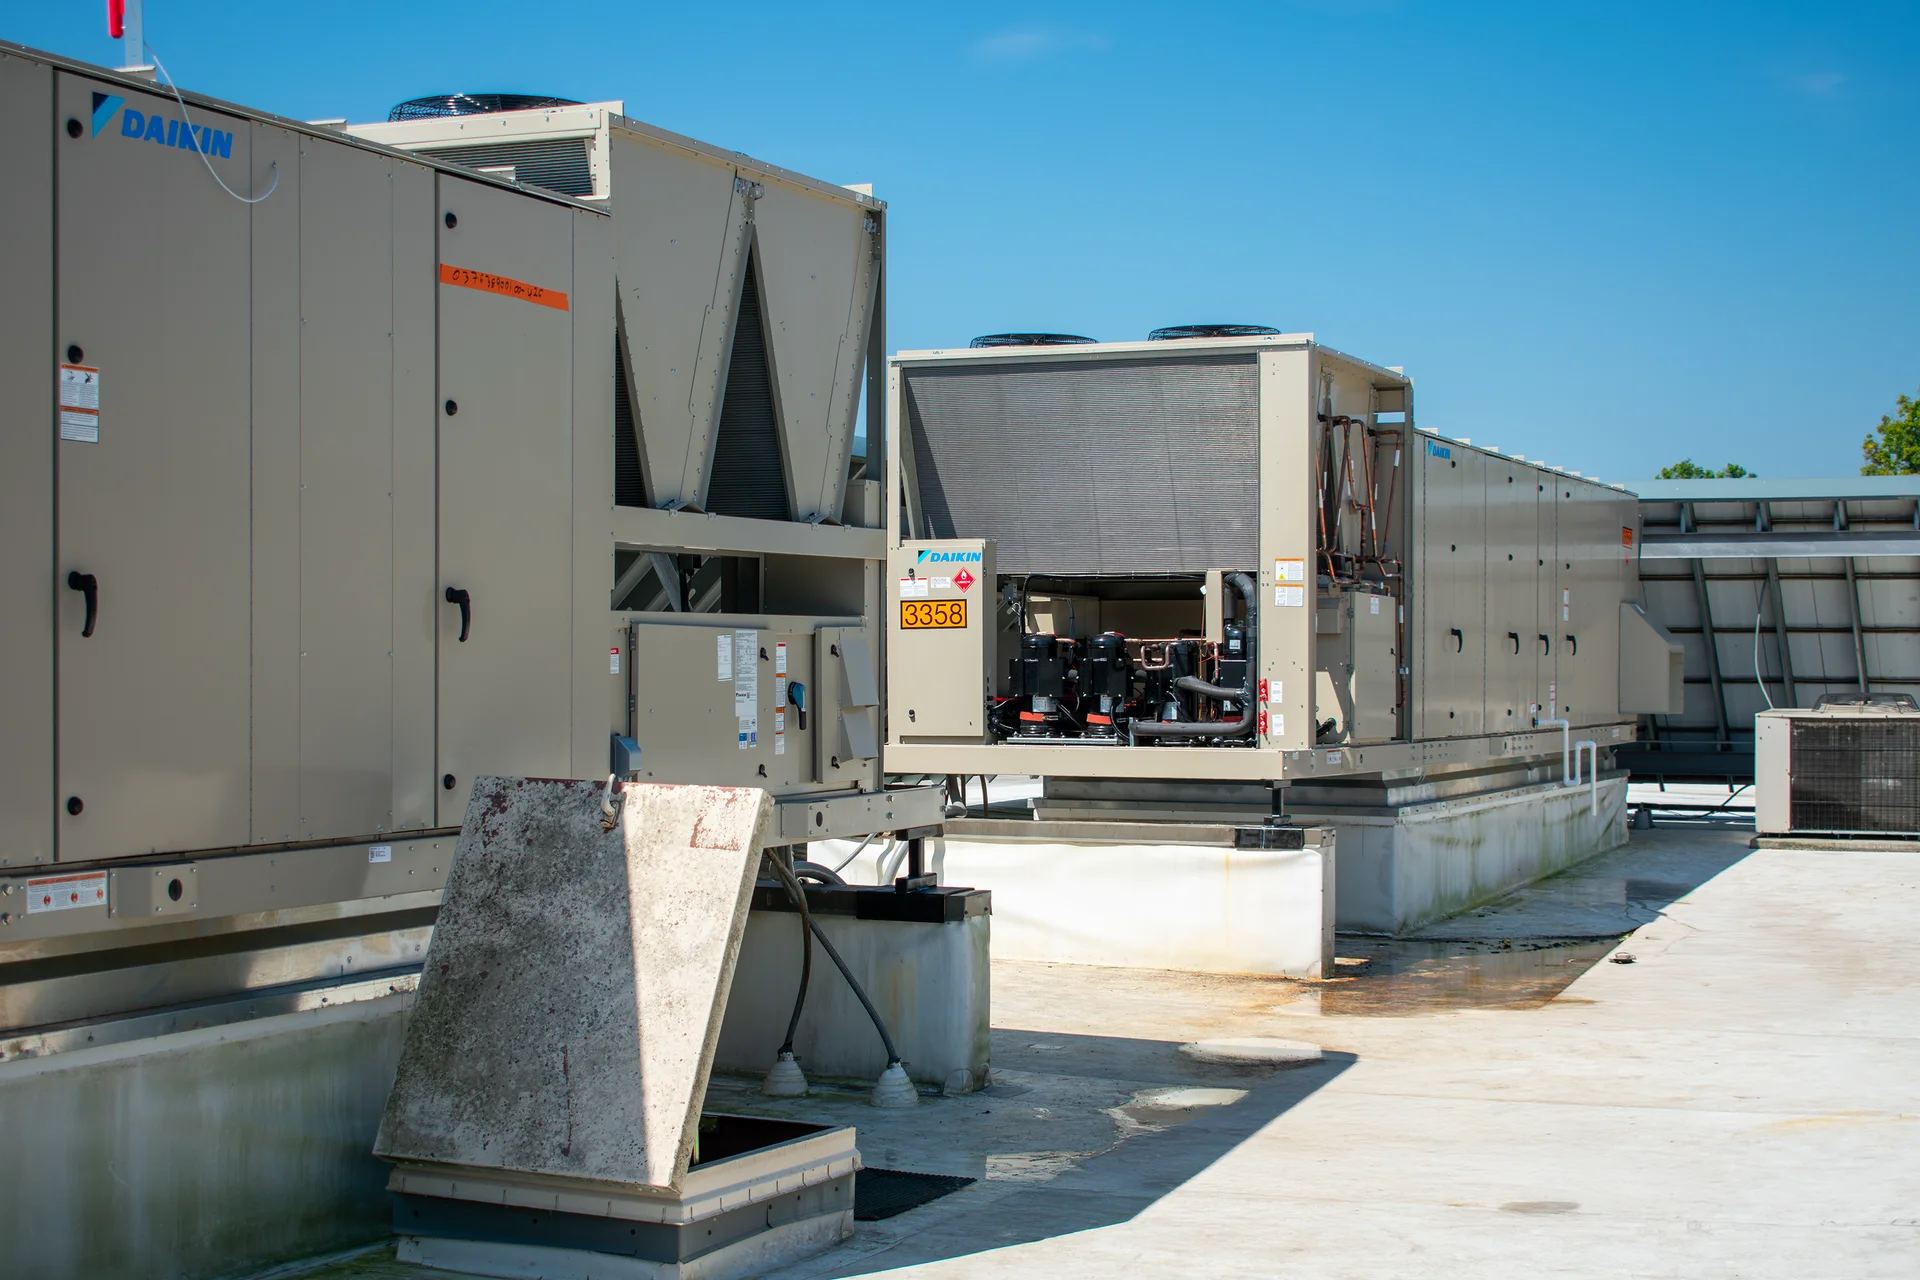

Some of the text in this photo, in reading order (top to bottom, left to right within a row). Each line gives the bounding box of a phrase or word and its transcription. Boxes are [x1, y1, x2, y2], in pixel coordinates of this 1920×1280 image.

[121, 109, 233, 159] DAIKIN
[930, 552, 981, 562] DAIKIN
[904, 603, 963, 626] 3358
